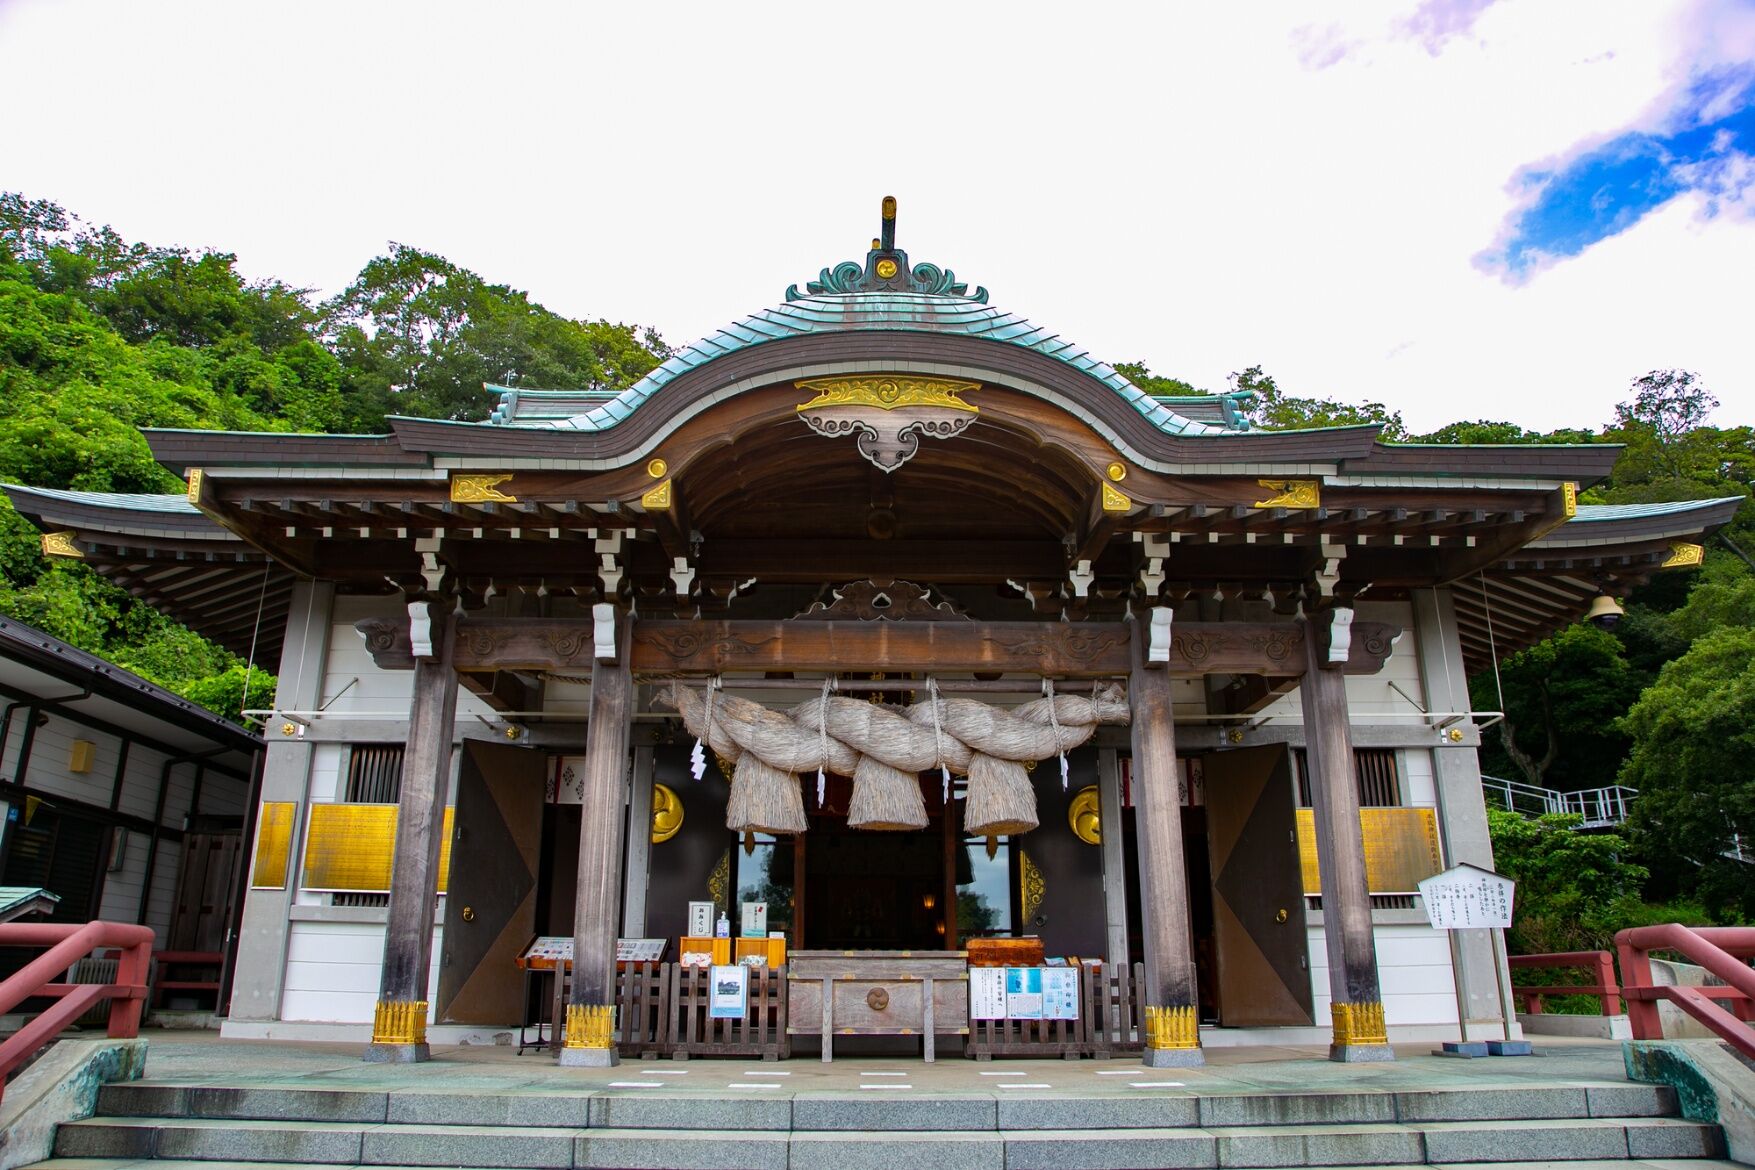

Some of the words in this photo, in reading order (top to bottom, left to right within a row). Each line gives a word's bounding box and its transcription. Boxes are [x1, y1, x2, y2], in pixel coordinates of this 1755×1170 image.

[1498, 882, 1508, 919] 参拝の作法
